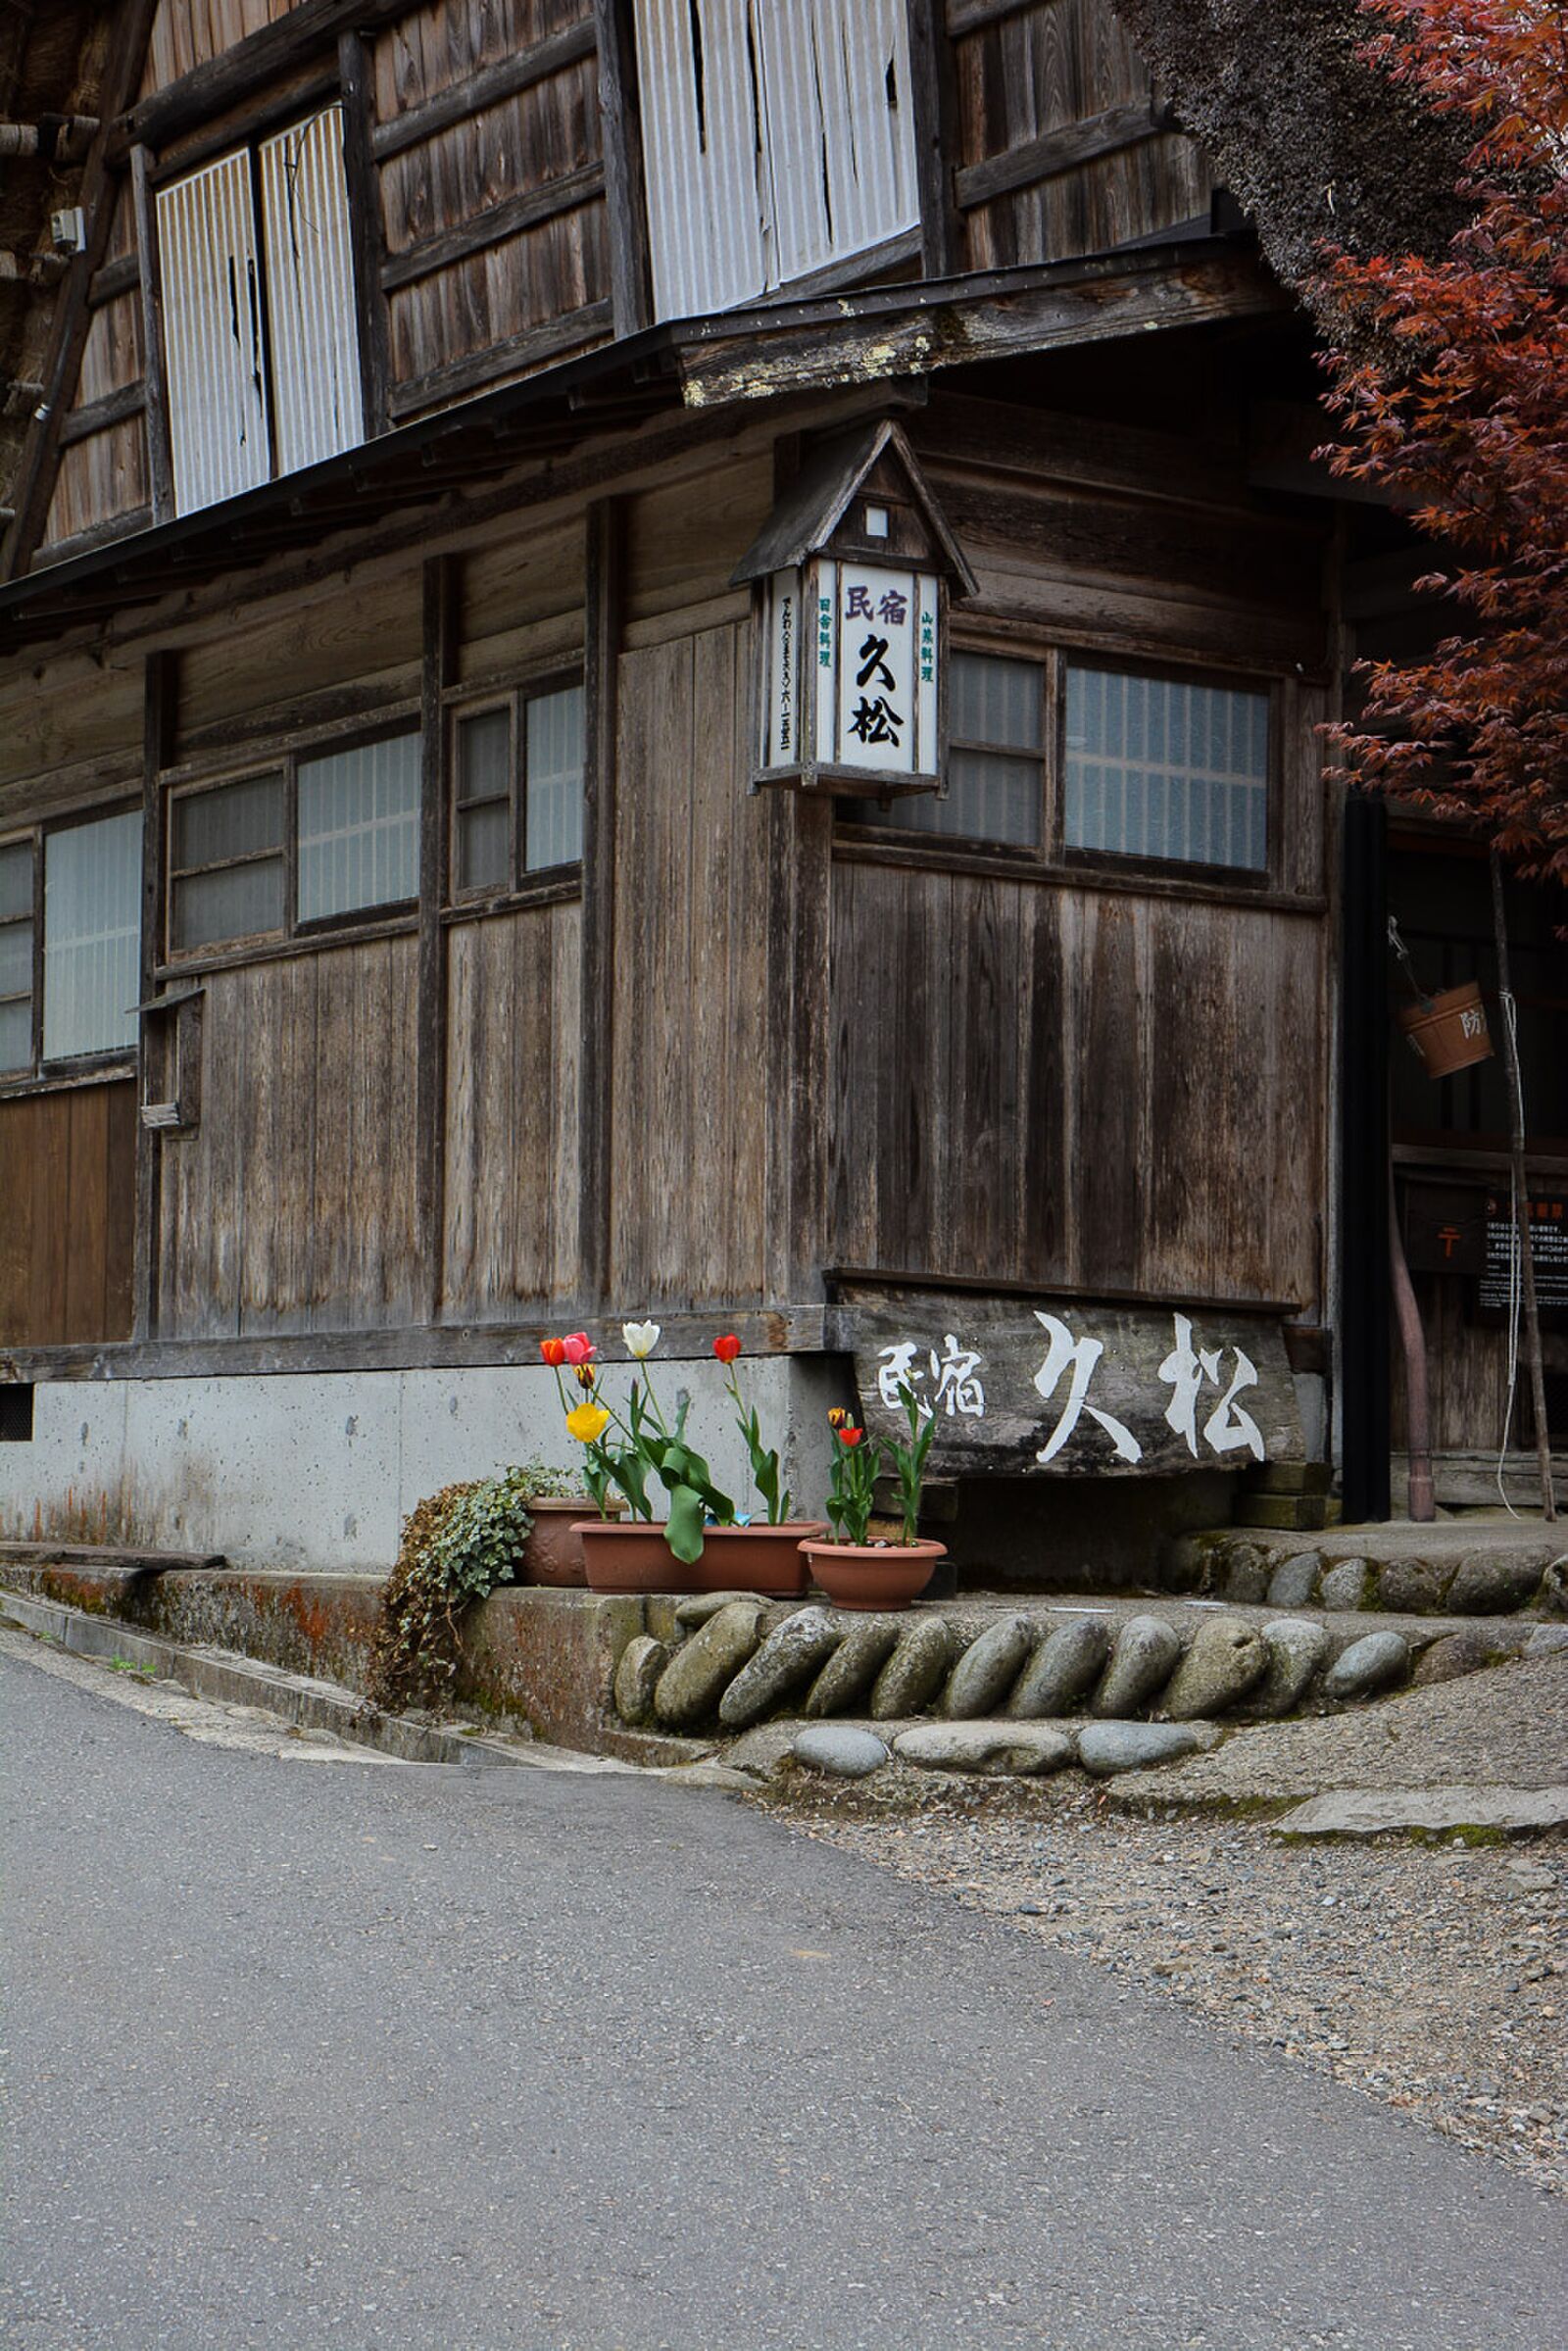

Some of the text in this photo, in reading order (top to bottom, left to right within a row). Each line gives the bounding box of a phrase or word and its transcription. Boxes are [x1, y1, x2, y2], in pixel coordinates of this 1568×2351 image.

[846, 586, 907, 625] 民宿
[848, 635, 904, 747] 久松
[877, 1310, 1265, 1464] 民宿 久松
